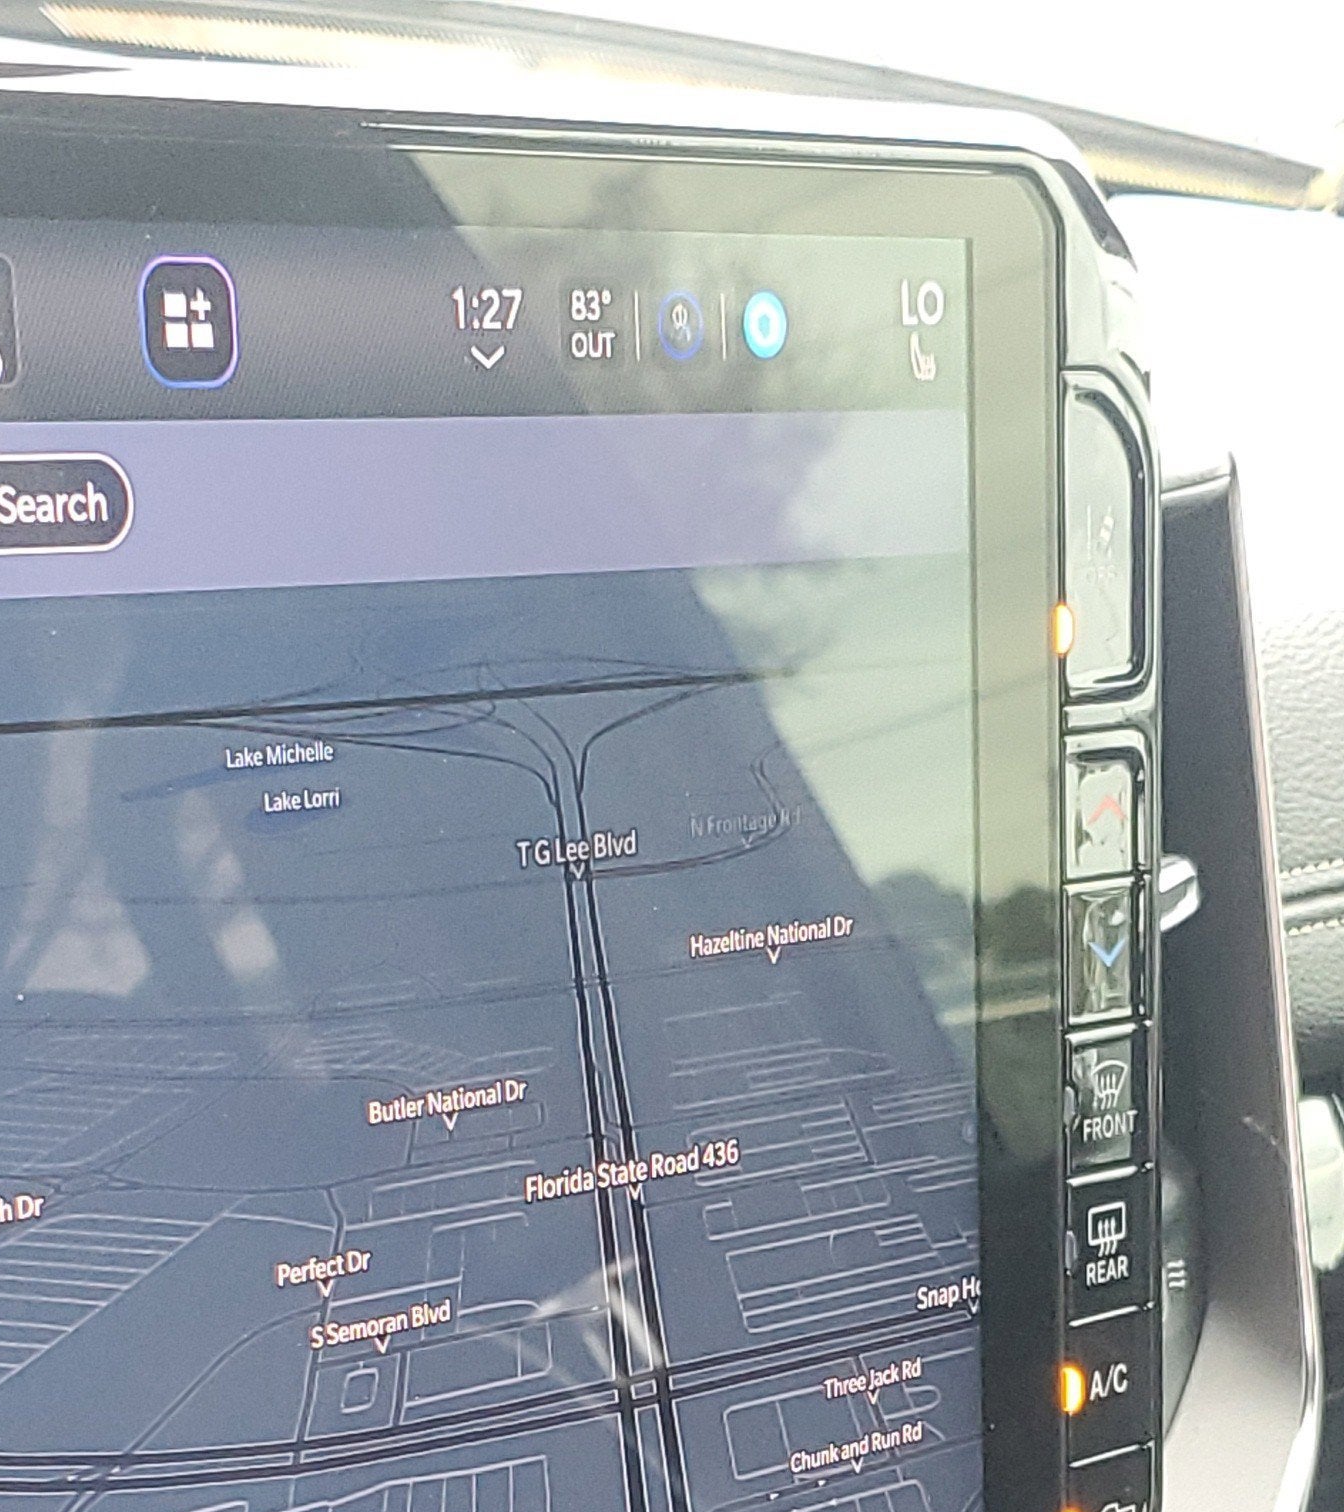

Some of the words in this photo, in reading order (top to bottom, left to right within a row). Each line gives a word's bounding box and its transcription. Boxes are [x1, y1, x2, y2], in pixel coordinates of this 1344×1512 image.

[452, 286, 523, 332] 1:27
[900, 280, 945, 326] LO
[571, 331, 616, 359] OUT
[225, 748, 264, 769] Lake
[266, 741, 334, 766] Michelle
[264, 791, 302, 812] Lake
[303, 787, 340, 808] Lorri
[516, 840, 532, 867] T
[533, 840, 550, 865] G
[556, 836, 591, 863] Lee
[593, 830, 637, 859] Blvd
[689, 925, 766, 958] Hazeltine
[766, 919, 832, 949] National
[833, 916, 854, 938] Dr
[368, 1096, 426, 1125] Butler
[427, 1085, 502, 1115] National
[503, 1079, 528, 1103] Dr
[1083, 1109, 1138, 1142] FRONT
[524, 1167, 596, 1203] Florida
[596, 1157, 649, 1189] State
[650, 1147, 700, 1178] Road
[702, 1138, 740, 1167] 436
[15, 1193, 45, 1221] Dr
[276, 1256, 345, 1288] Perfect
[346, 1248, 372, 1275] Dr
[1086, 1255, 1130, 1287] REAR
[916, 1284, 960, 1311] Snap
[311, 1326, 325, 1349] S
[325, 1310, 409, 1345] Semoran
[410, 1299, 452, 1329] Blvd
[823, 1372, 867, 1399] Three
[867, 1364, 900, 1391] Jack
[901, 1357, 923, 1381] Rd
[1089, 1362, 1129, 1400] A/C
[790, 1442, 840, 1473] Chunk
[840, 1437, 870, 1460] and
[871, 1429, 901, 1452] Run
[902, 1421, 923, 1443] Rd
